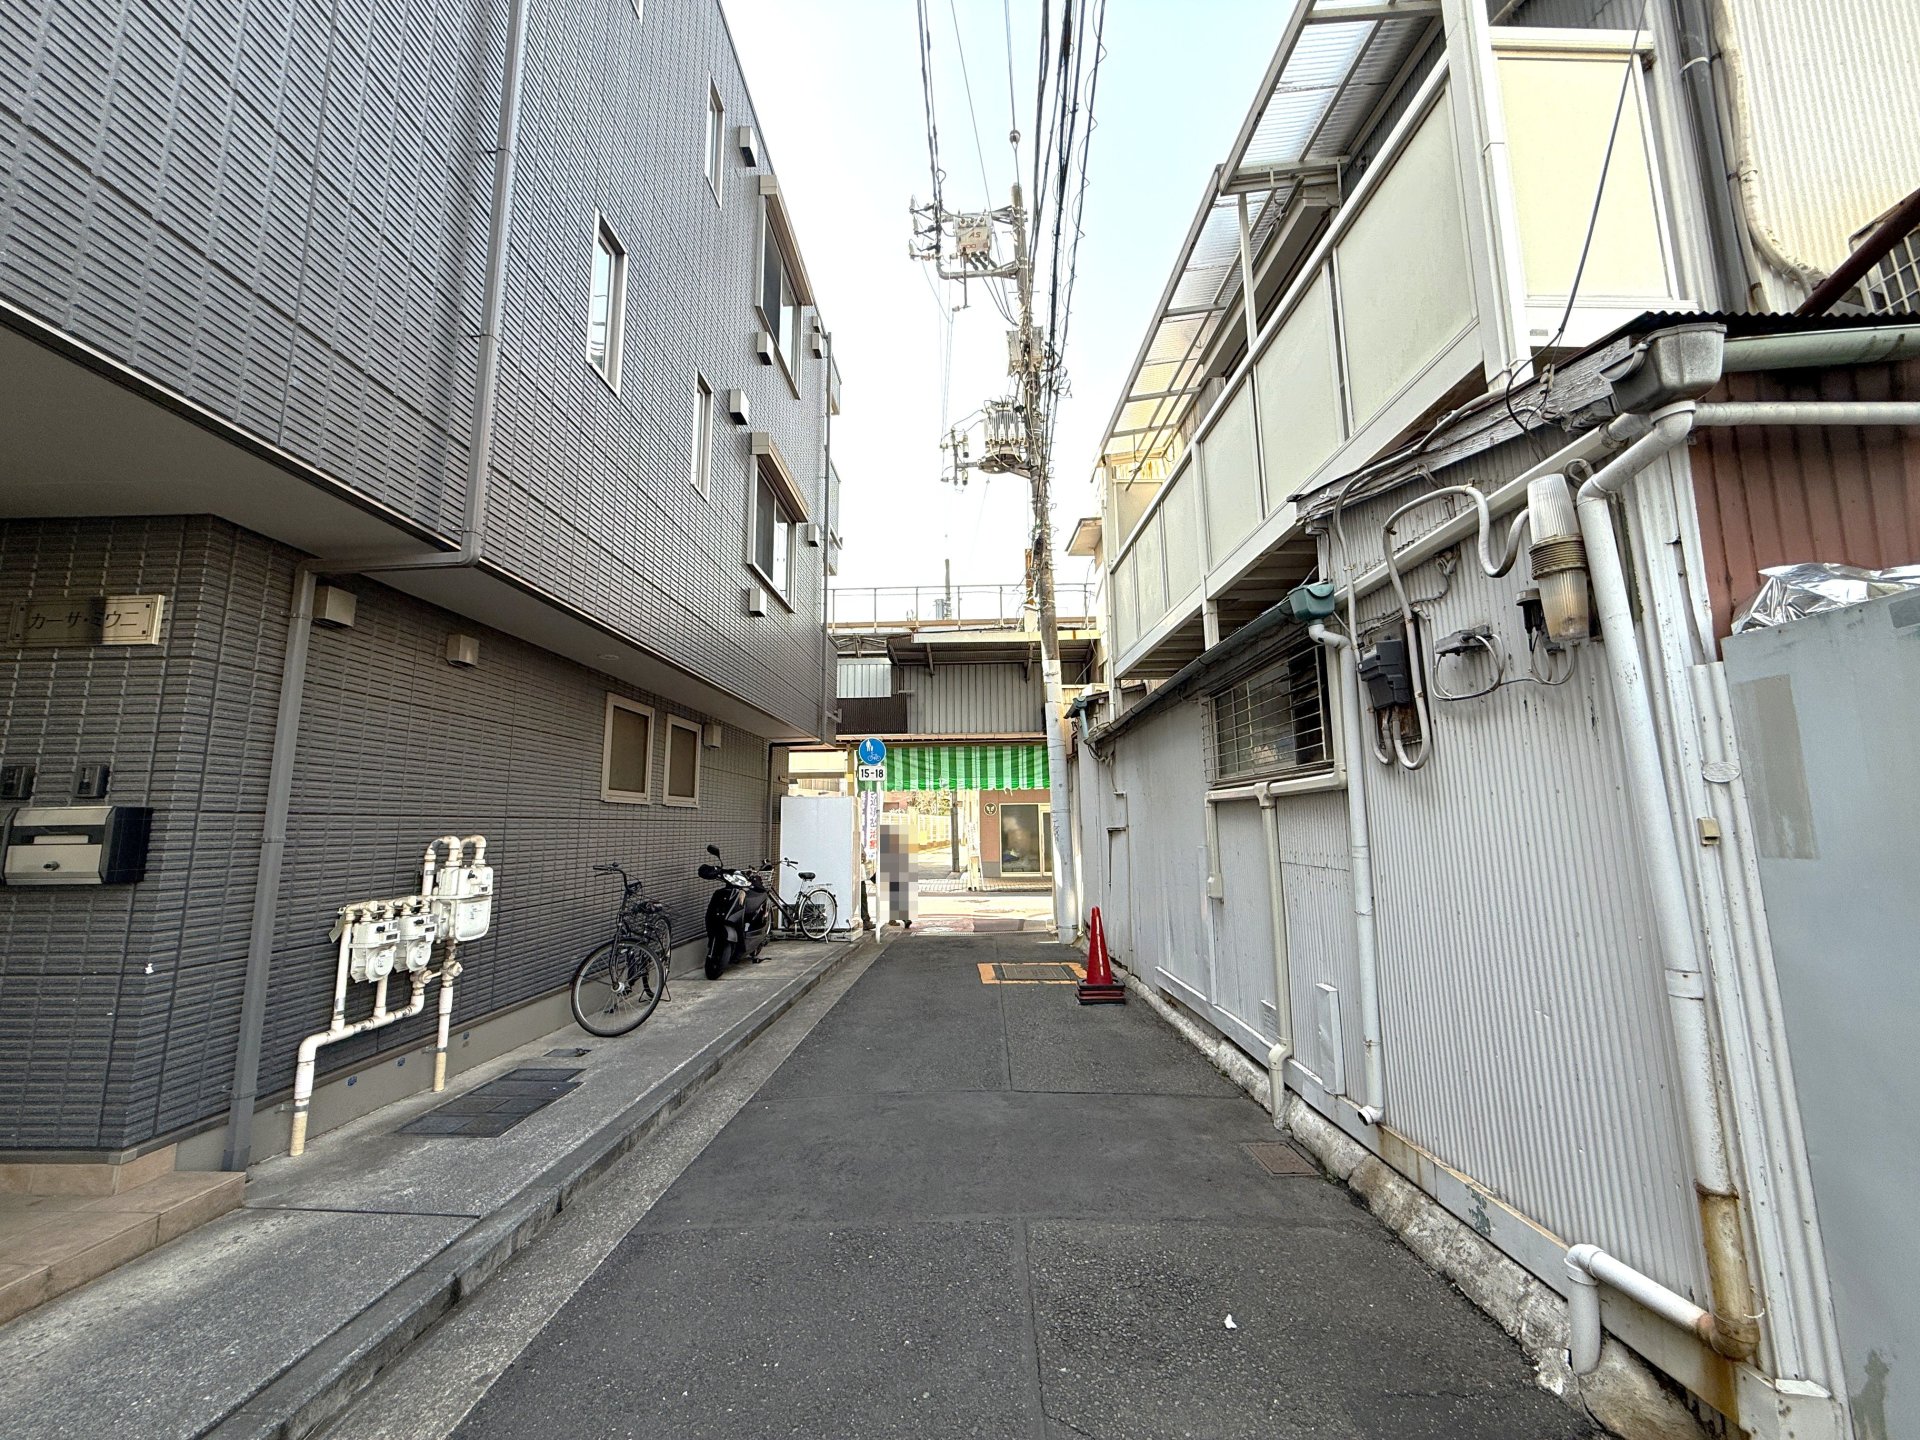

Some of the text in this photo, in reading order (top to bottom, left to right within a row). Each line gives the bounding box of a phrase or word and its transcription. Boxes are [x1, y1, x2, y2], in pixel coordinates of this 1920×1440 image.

[28, 610, 140, 630] カーサ・ミウニ
[861, 768, 884, 779] 15-18
